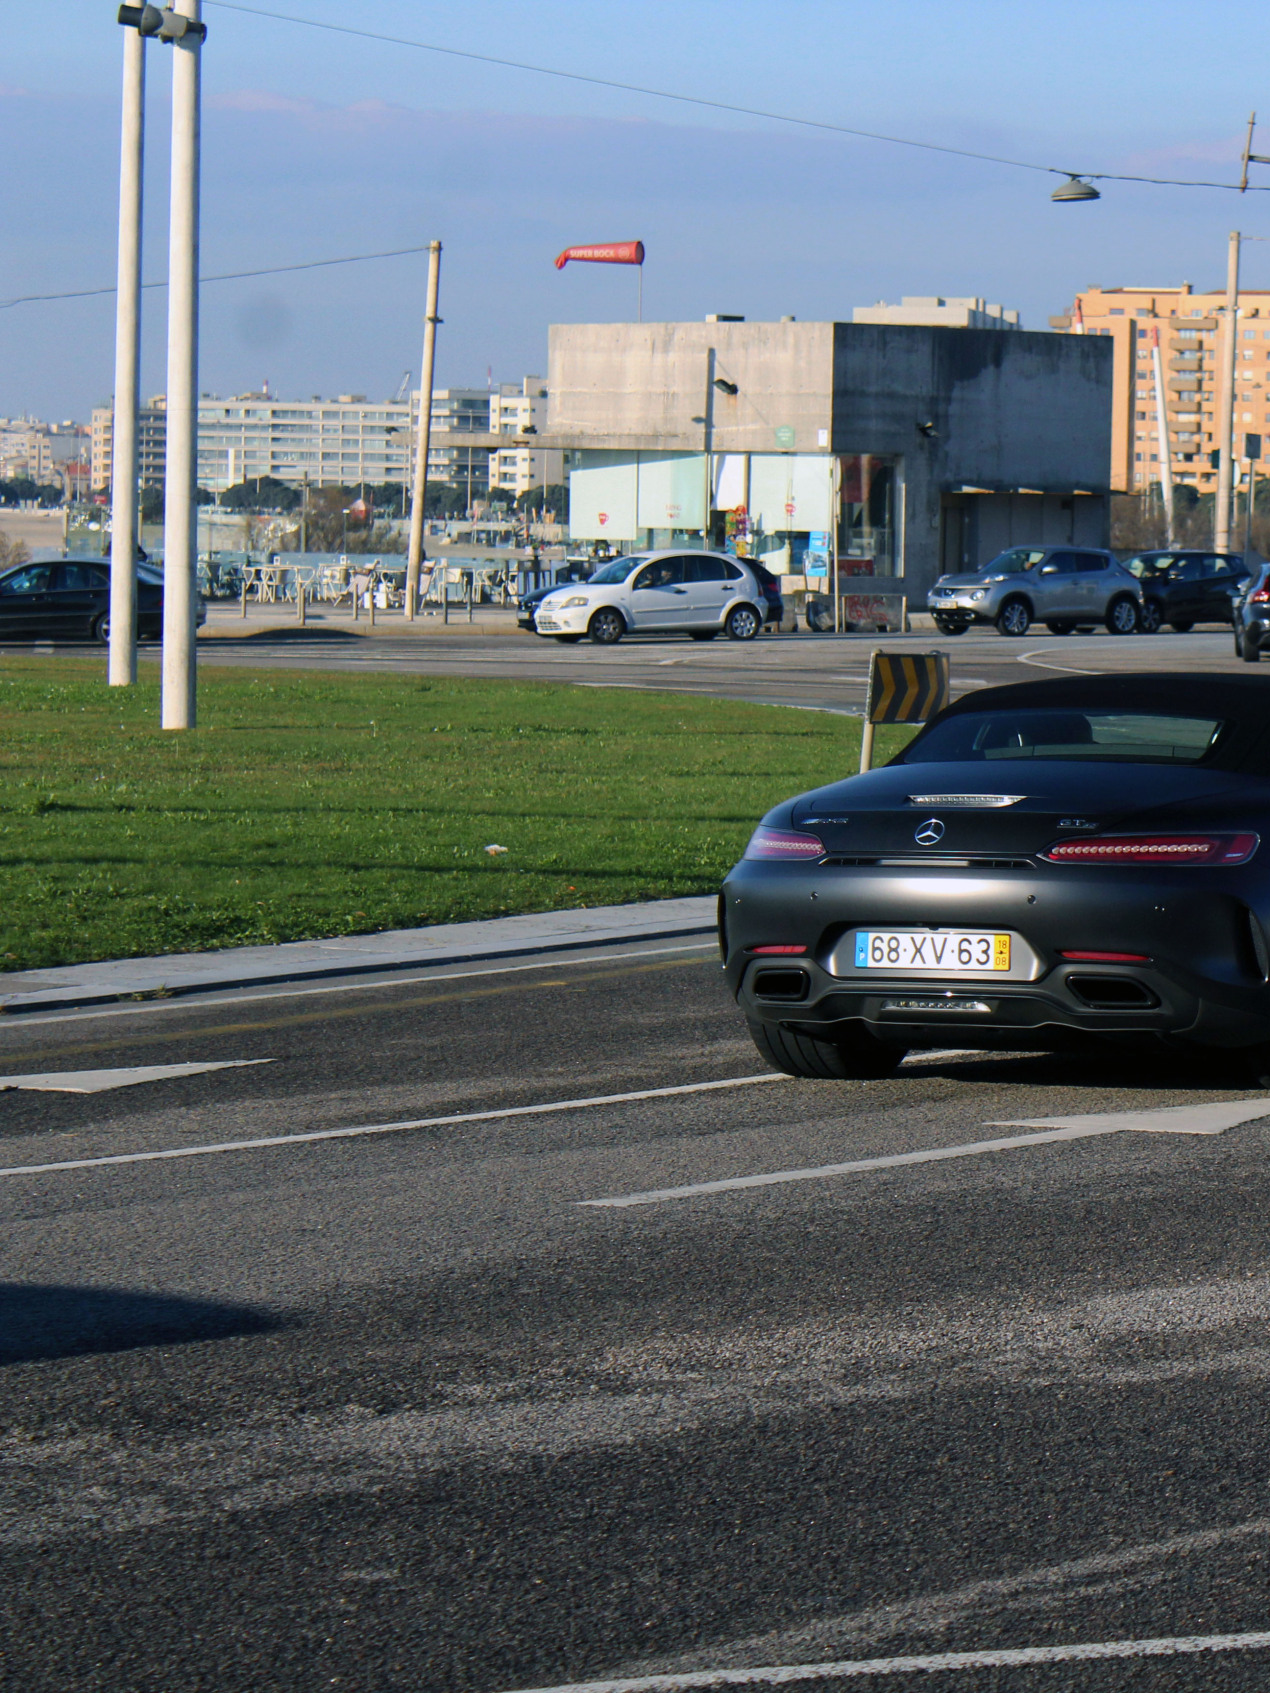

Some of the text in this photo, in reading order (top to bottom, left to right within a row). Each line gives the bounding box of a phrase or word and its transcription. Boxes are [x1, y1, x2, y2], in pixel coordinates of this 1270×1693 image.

[569, 249, 615, 258] SUPER BOCK
[998, 939, 1008, 949] 18
[859, 953, 866, 961] P
[995, 956, 1007, 966] 08
